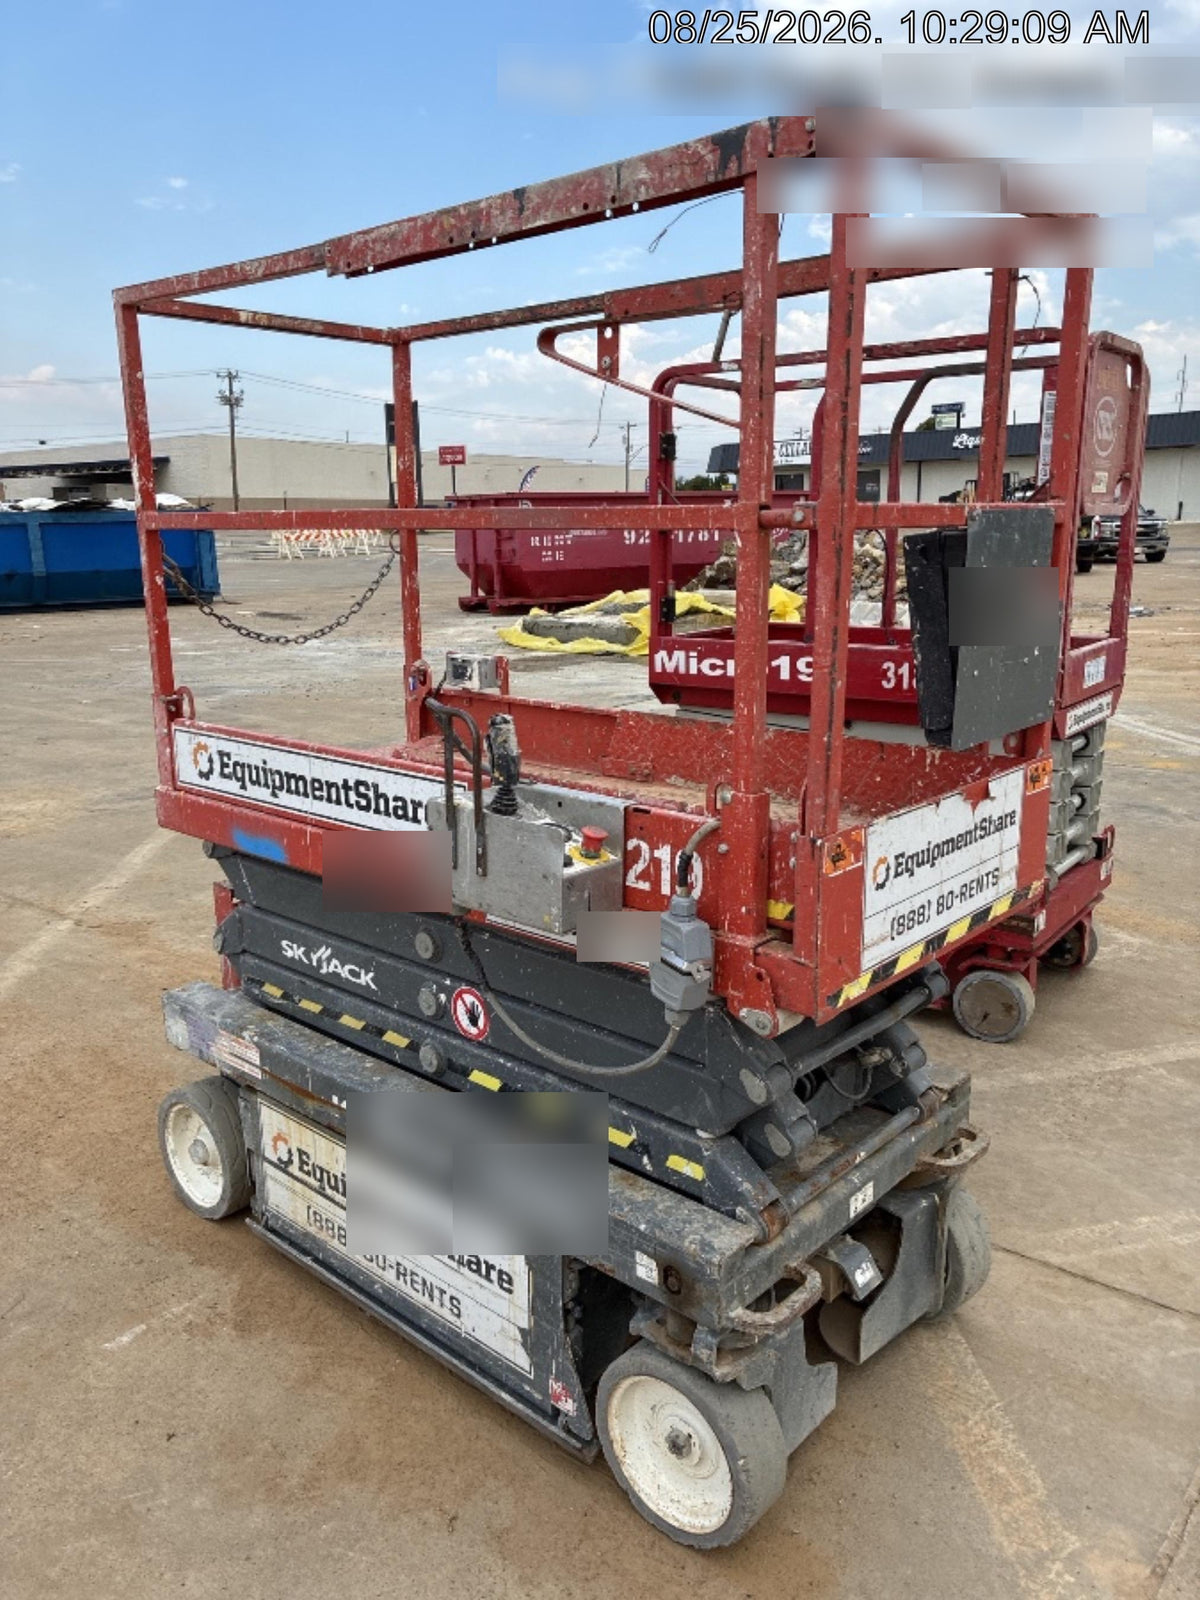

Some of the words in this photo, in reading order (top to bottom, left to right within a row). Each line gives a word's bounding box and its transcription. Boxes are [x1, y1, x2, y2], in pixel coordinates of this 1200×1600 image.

[881, 661, 917, 690] 31
[217, 750, 428, 826] EquipmentShar
[893, 809, 1017, 879] EquipmentShare
[890, 899, 932, 941] (888)
[936, 867, 1000, 916] 80-RENTS
[281, 940, 378, 991] SKYJACK
